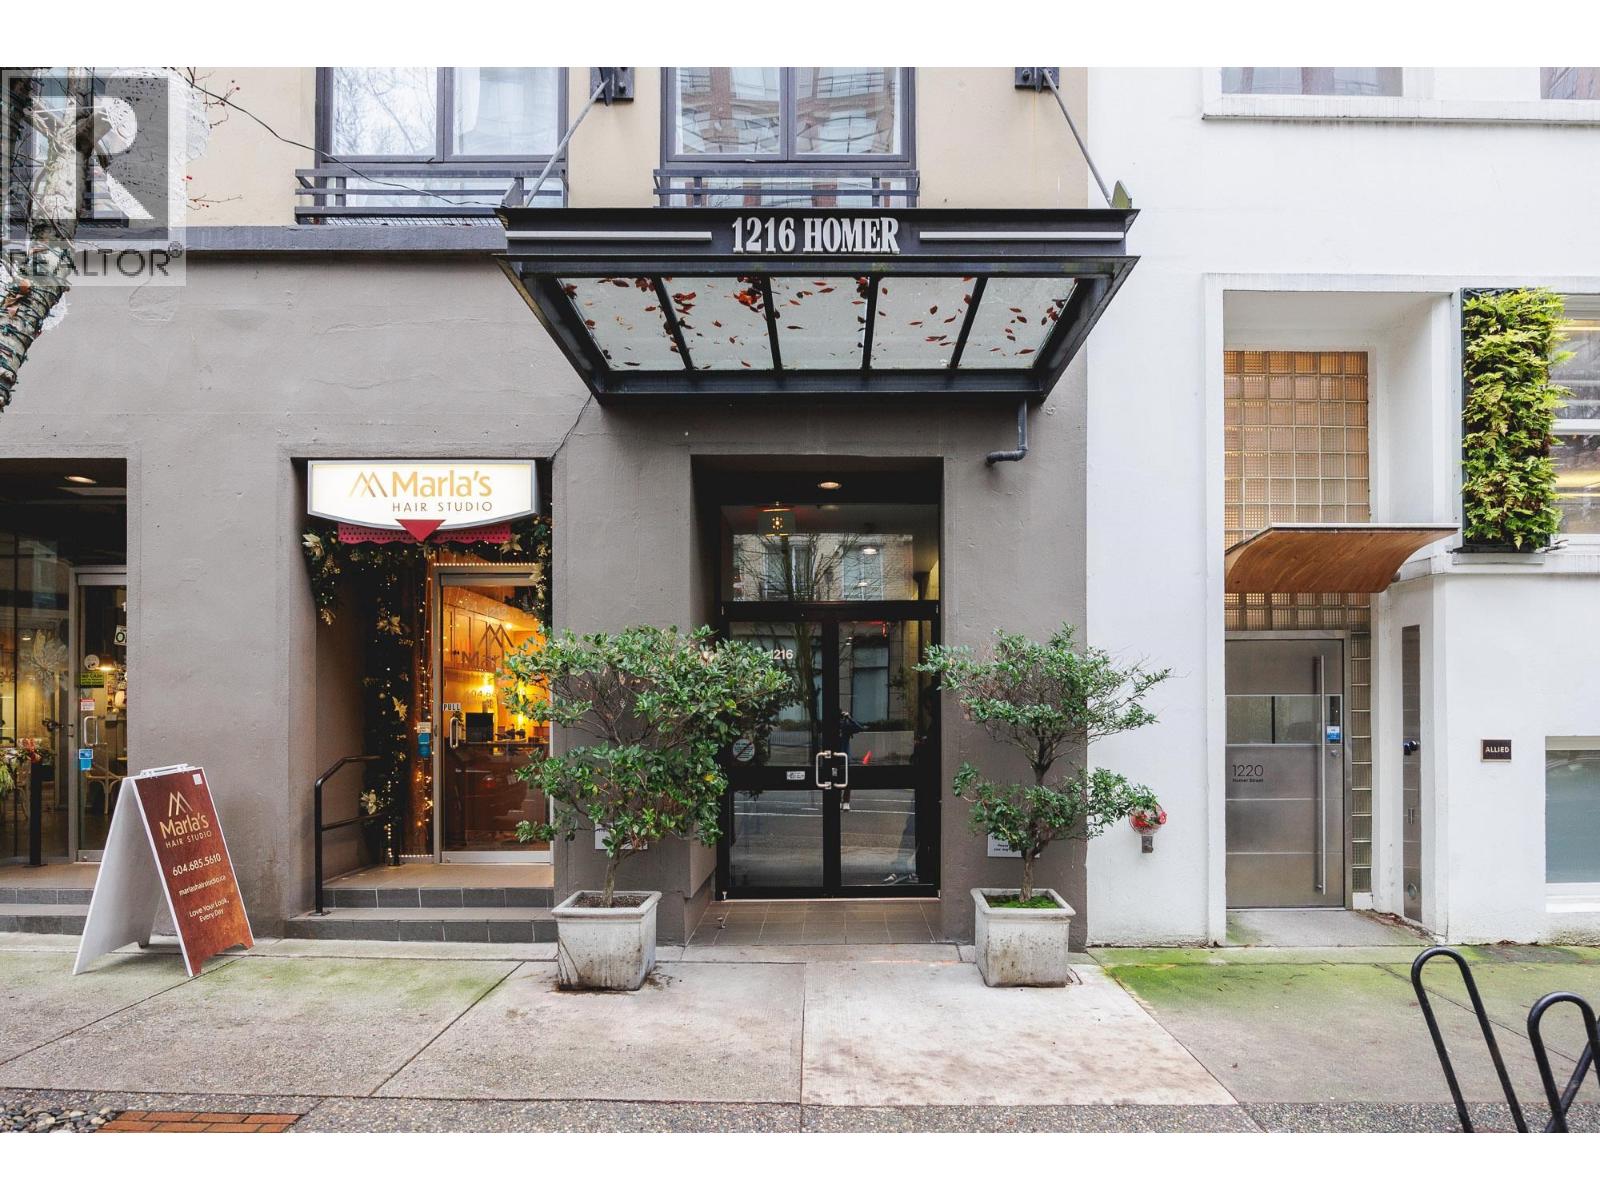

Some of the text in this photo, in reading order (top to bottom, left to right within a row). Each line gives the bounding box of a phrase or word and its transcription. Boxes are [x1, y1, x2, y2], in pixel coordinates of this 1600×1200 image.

[732, 216, 901, 255] 1216 HOMER
[392, 470, 493, 498] Marla's
[392, 501, 493, 512] HAIR STUDIO
[443, 703, 460, 711] PULL
[1232, 764, 1264, 777] 1220
[159, 812, 210, 839] Marla's
[165, 830, 212, 849] HAIR STUDIO
[172, 853, 222, 876] 604.685.5610
[189, 907, 204, 918] Love
[202, 903, 216, 912] Your
[198, 908, 225, 922] Every Day
